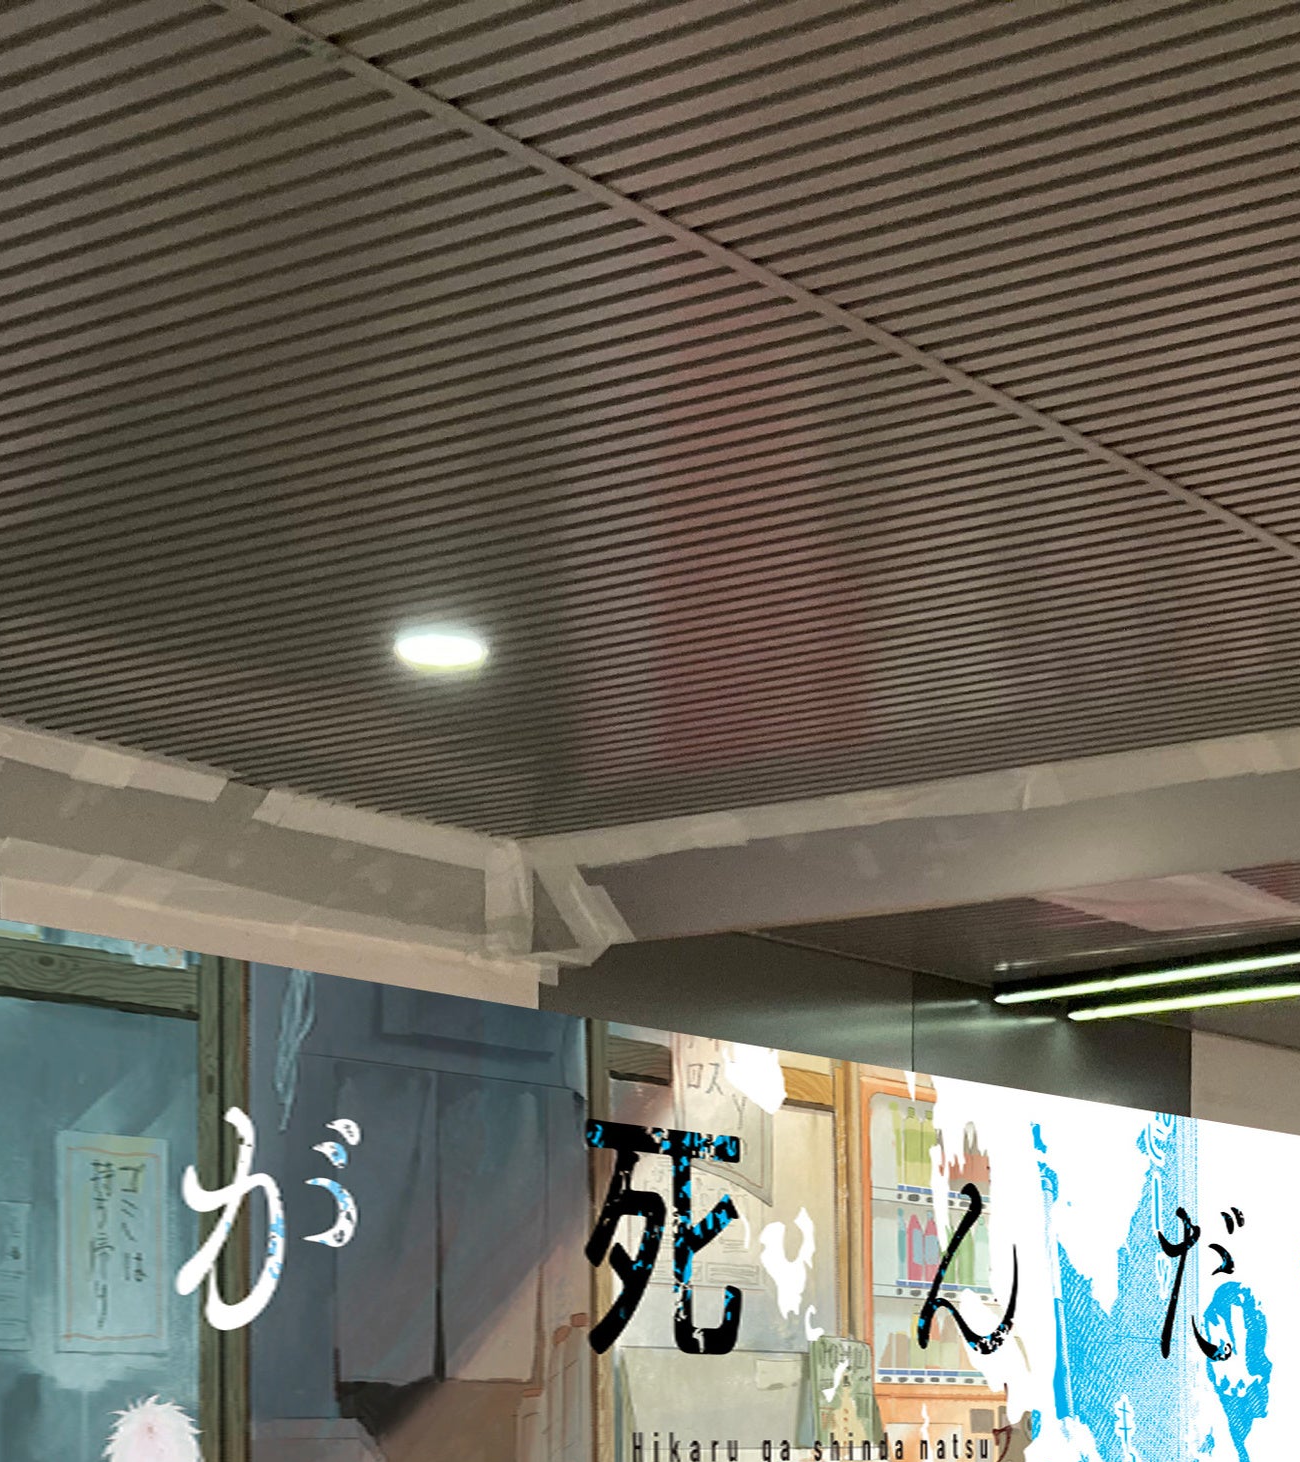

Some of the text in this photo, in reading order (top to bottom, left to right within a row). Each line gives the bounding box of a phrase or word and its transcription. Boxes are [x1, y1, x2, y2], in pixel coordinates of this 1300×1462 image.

[632, 1432, 739, 1462] Hikaru
[813, 1432, 904, 1462] shinda
[919, 1432, 990, 1460] natsu
